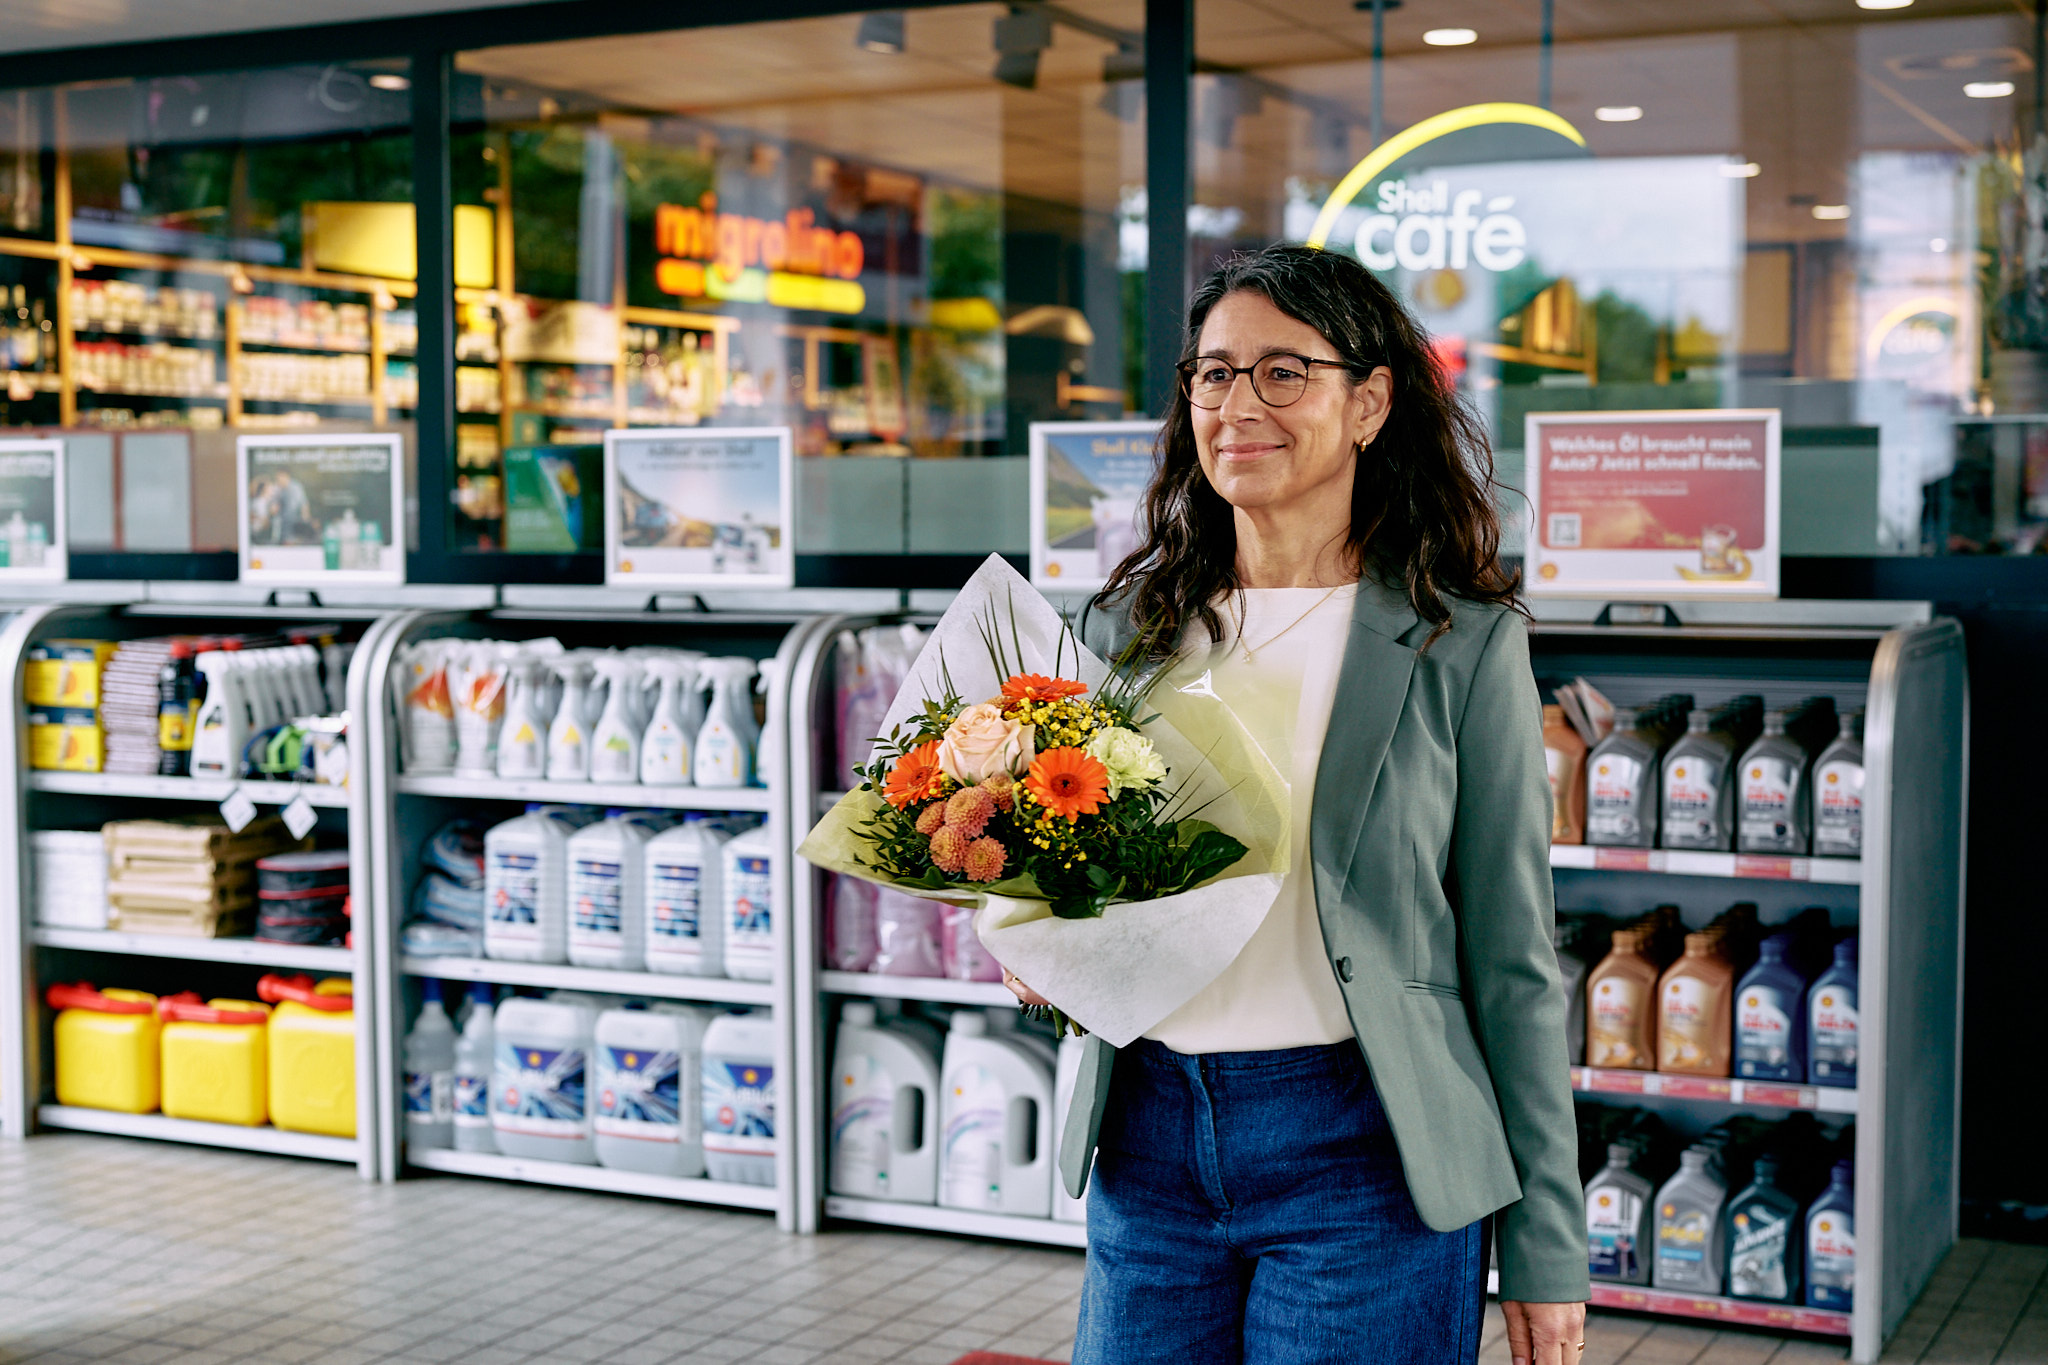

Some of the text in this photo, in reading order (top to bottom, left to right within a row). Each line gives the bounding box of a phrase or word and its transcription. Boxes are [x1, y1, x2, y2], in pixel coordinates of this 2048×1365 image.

[1377, 179, 1448, 213] Shell
[656, 190, 865, 282] migrolino
[1354, 189, 1527, 272] café
[1549, 431, 1752, 452] Welches Öl braucht mein
[1549, 452, 1762, 472] Auto? Jetzt schnell finden.
